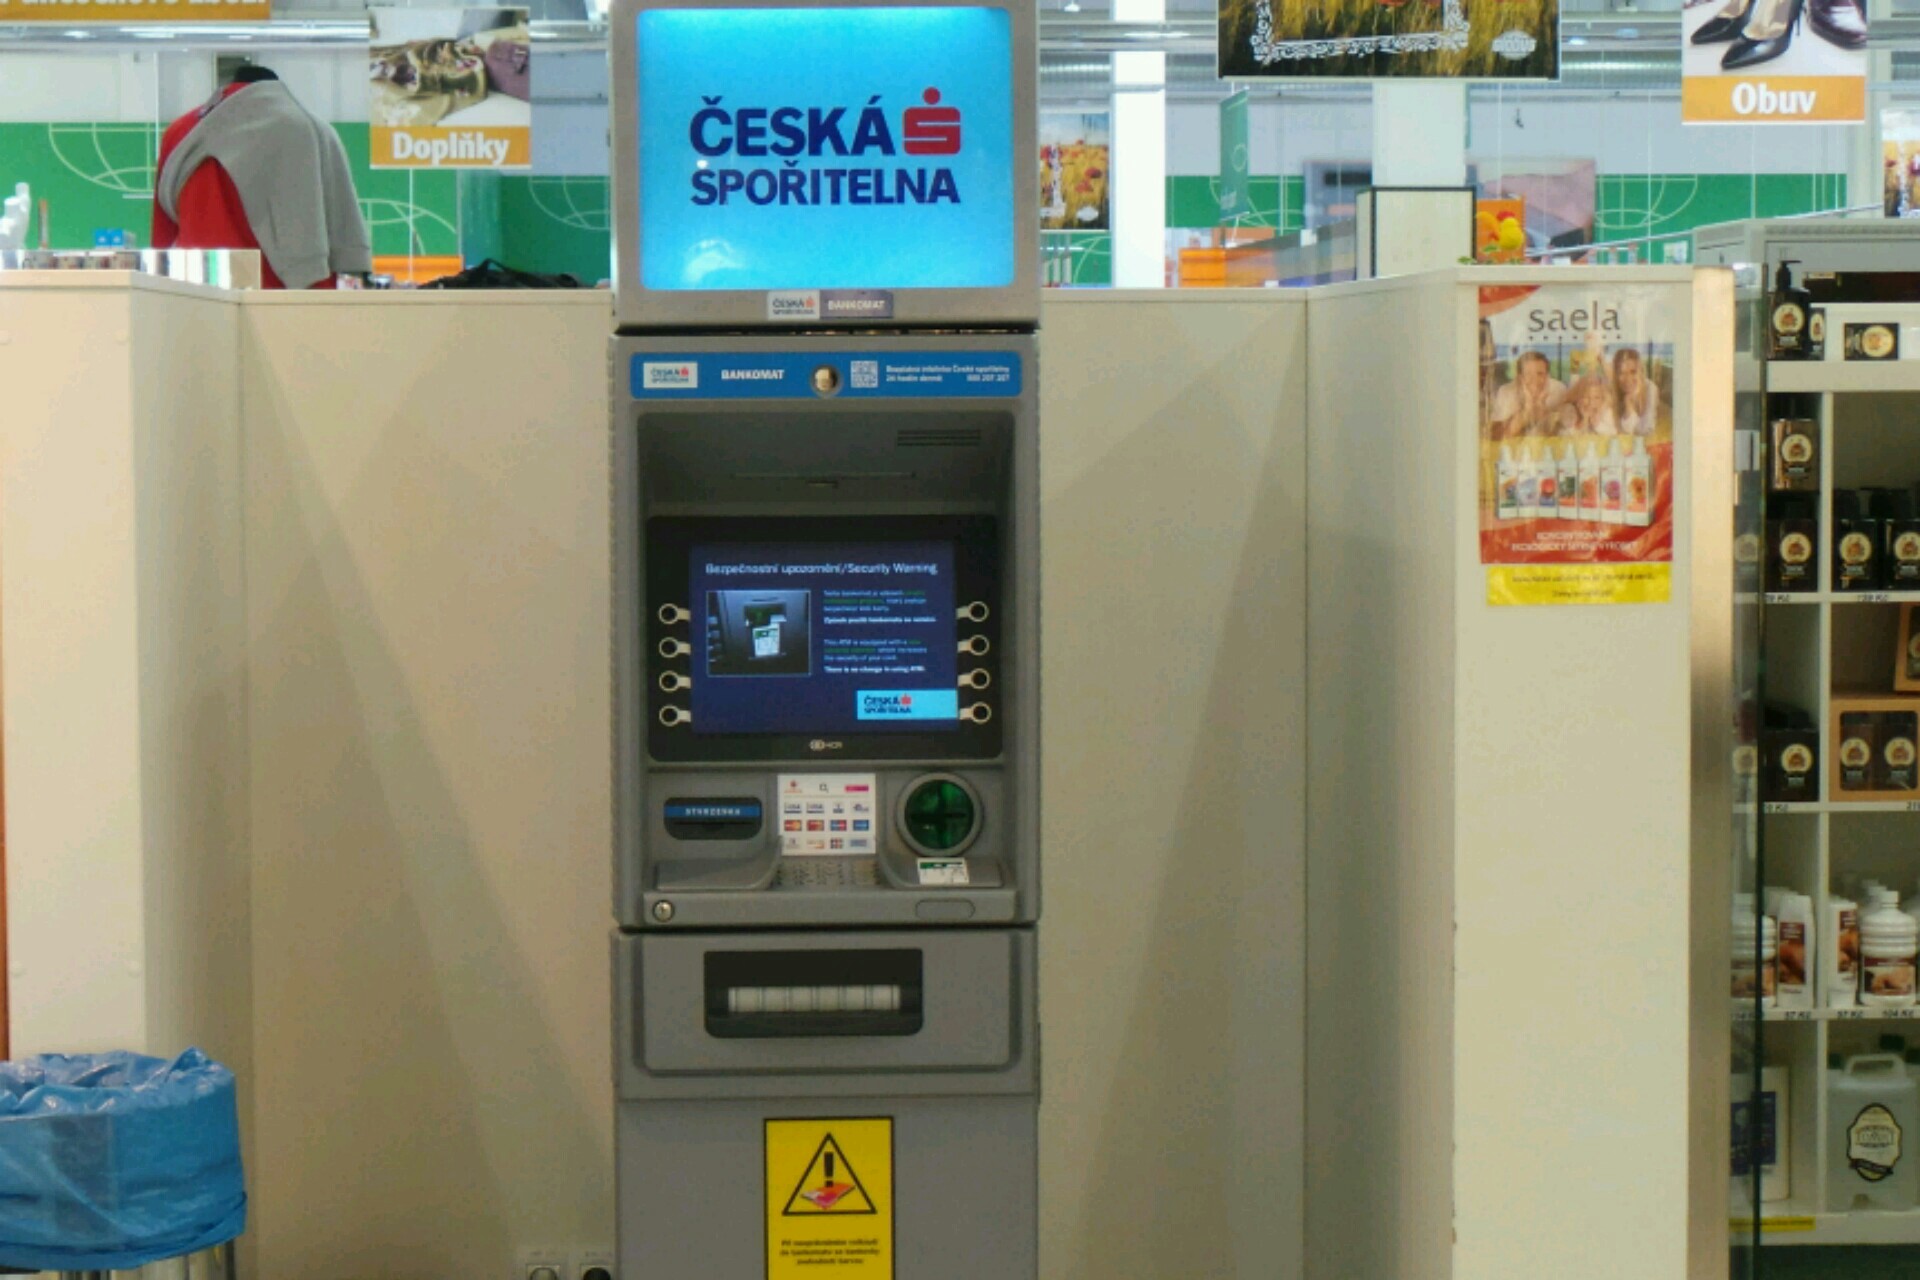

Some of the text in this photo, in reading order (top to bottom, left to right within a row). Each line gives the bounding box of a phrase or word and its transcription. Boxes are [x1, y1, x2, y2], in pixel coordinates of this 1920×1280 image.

[1732, 82, 1816, 115] Obuv
[690, 95, 896, 157] ČESKÁ
[392, 129, 510, 165] Doplňky
[690, 160, 961, 206] SPOŘITELNA
[828, 300, 885, 311] BANKOMAT
[1528, 300, 1621, 333] saela
[721, 369, 785, 380] BANKOMAT
[705, 562, 778, 576] Bezpečnostní
[894, 562, 938, 576] Warning
